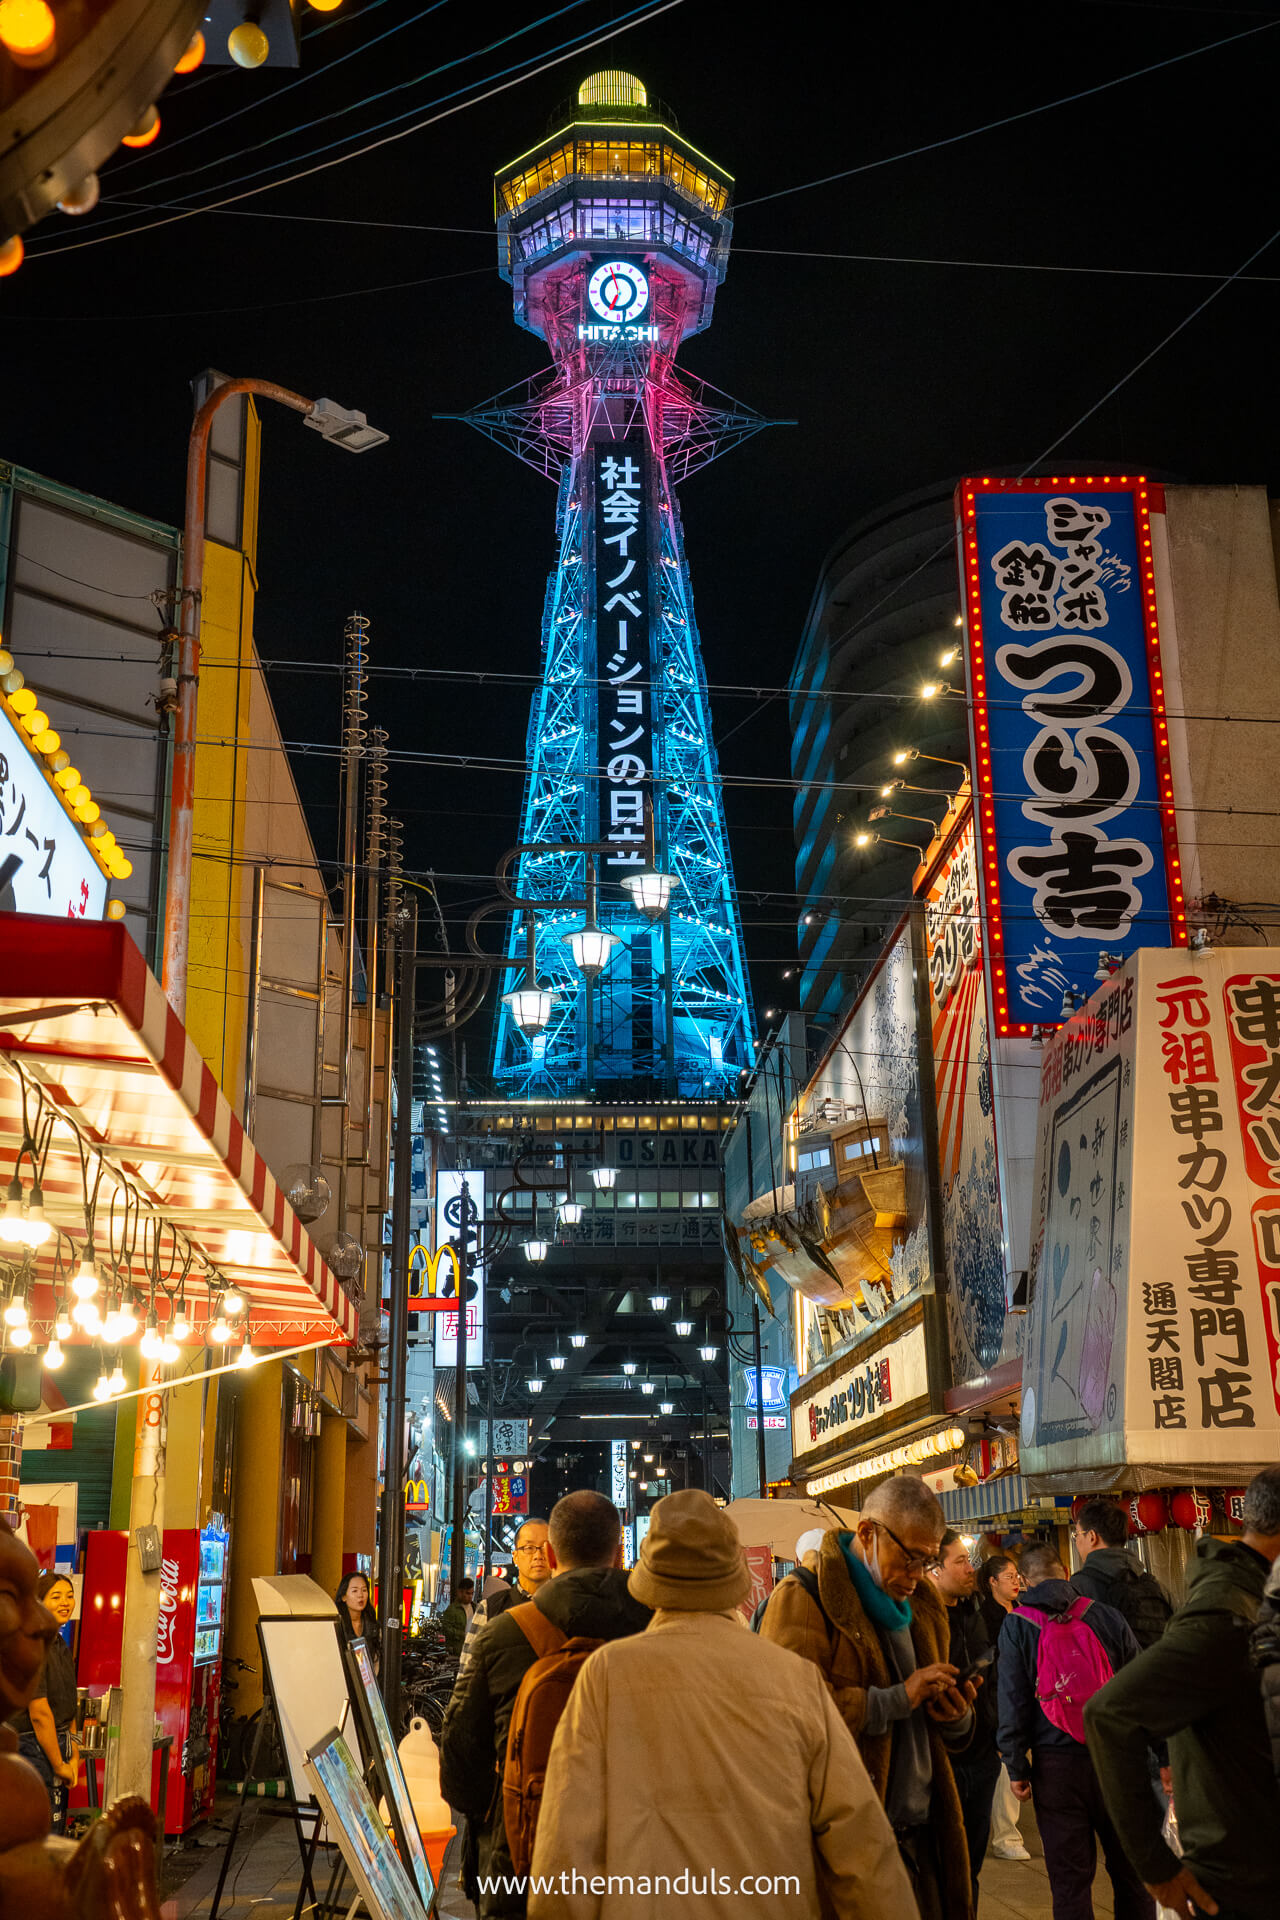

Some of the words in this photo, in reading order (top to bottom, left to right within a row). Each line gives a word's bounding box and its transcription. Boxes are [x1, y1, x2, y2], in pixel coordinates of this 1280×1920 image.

[578, 325, 659, 341] HITACHI
[997, 546, 1056, 626] 釣船
[1050, 500, 1107, 626] ジャンボ
[600, 456, 646, 865] 社会イノベーションの日立
[1004, 642, 1145, 930] つり吉
[619, 1138, 717, 1162] OSAKA
[1156, 975, 1256, 1429] 元祖串カツ専門店
[1141, 1282, 1188, 1431] 通天閣店
